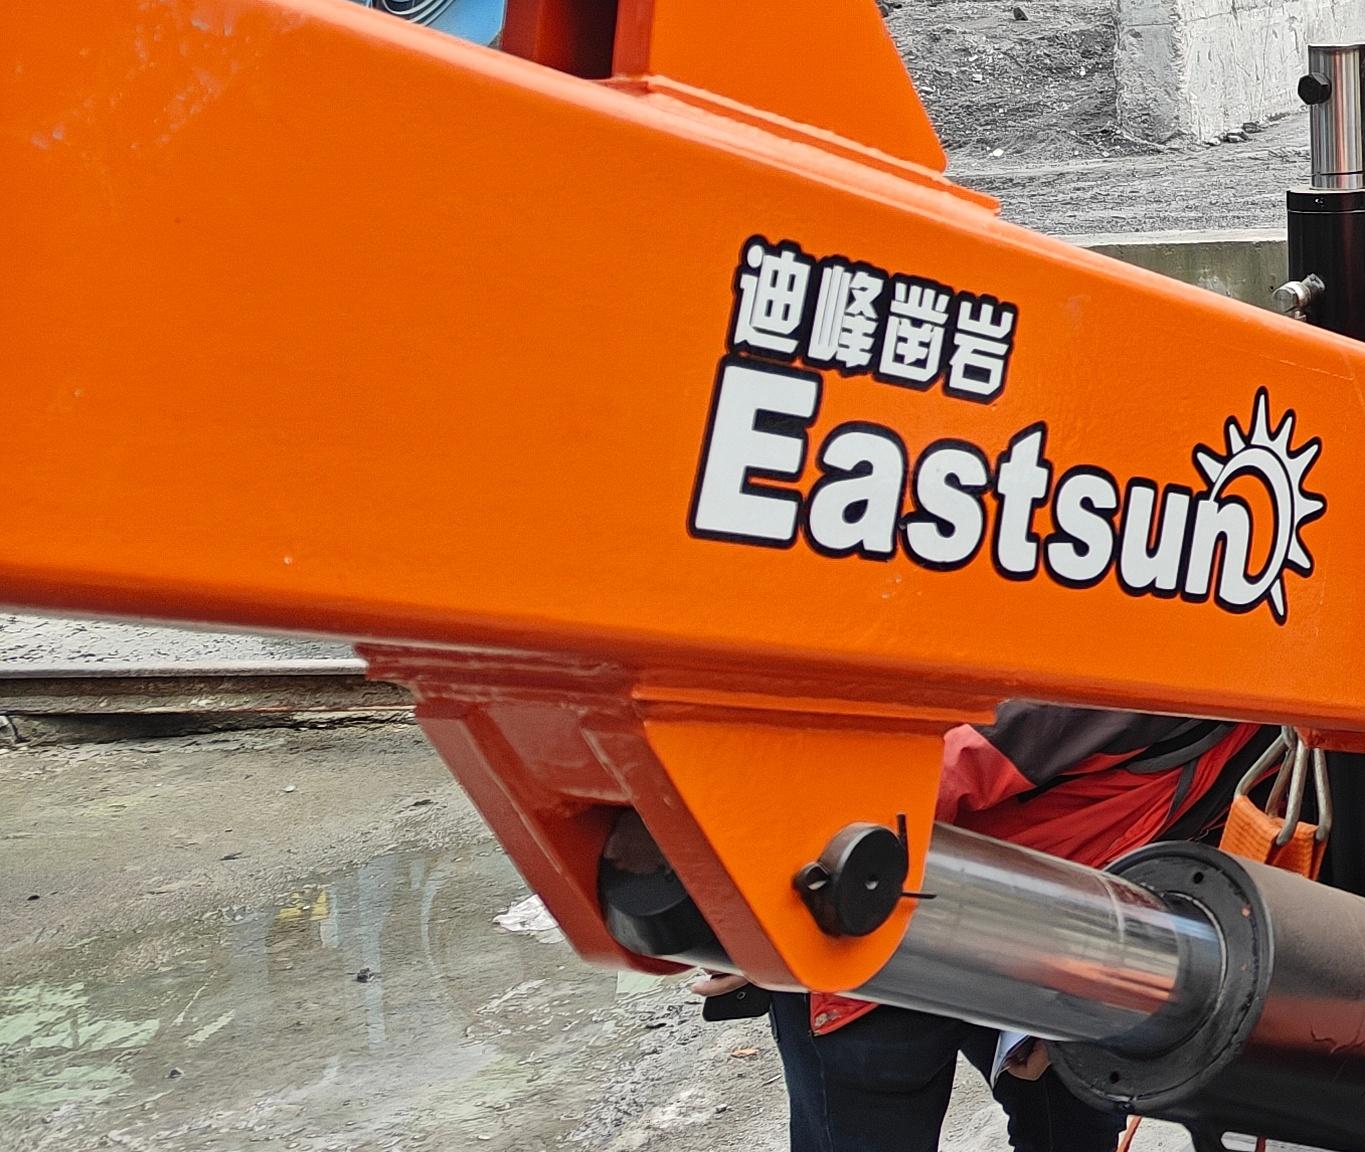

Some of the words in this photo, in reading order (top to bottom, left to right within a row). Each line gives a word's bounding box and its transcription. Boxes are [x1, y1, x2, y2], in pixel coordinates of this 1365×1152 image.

[733, 240, 1014, 398] 迪峰凿岩
[692, 360, 1300, 610] Eastsun
